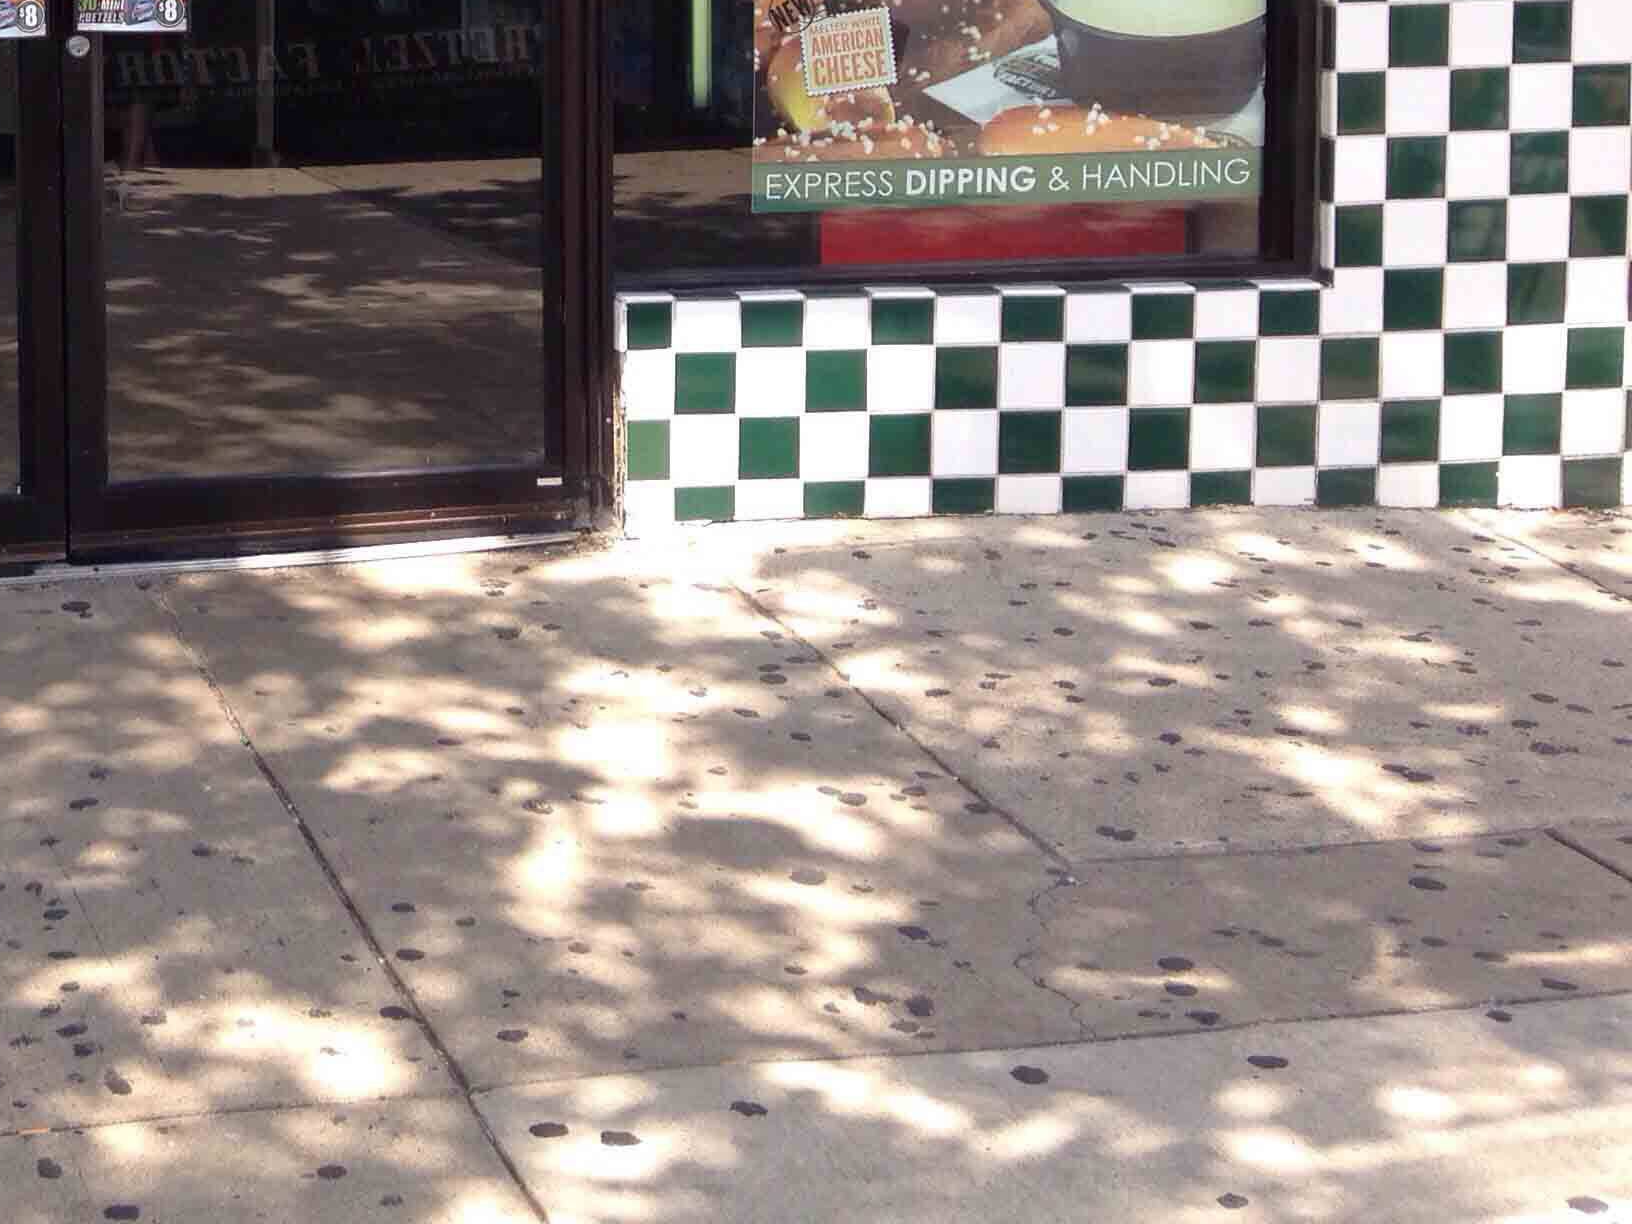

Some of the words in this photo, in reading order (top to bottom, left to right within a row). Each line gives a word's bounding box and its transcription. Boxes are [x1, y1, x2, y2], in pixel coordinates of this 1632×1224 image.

[19, 4, 39, 28] $8
[811, 29, 885, 57] AMERICAN
[812, 49, 889, 87] CHEESE
[765, 168, 894, 202] EXPRESS
[905, 165, 1037, 197] DIPPING
[1048, 166, 1071, 191] &
[1082, 157, 1252, 191] HANDLING
